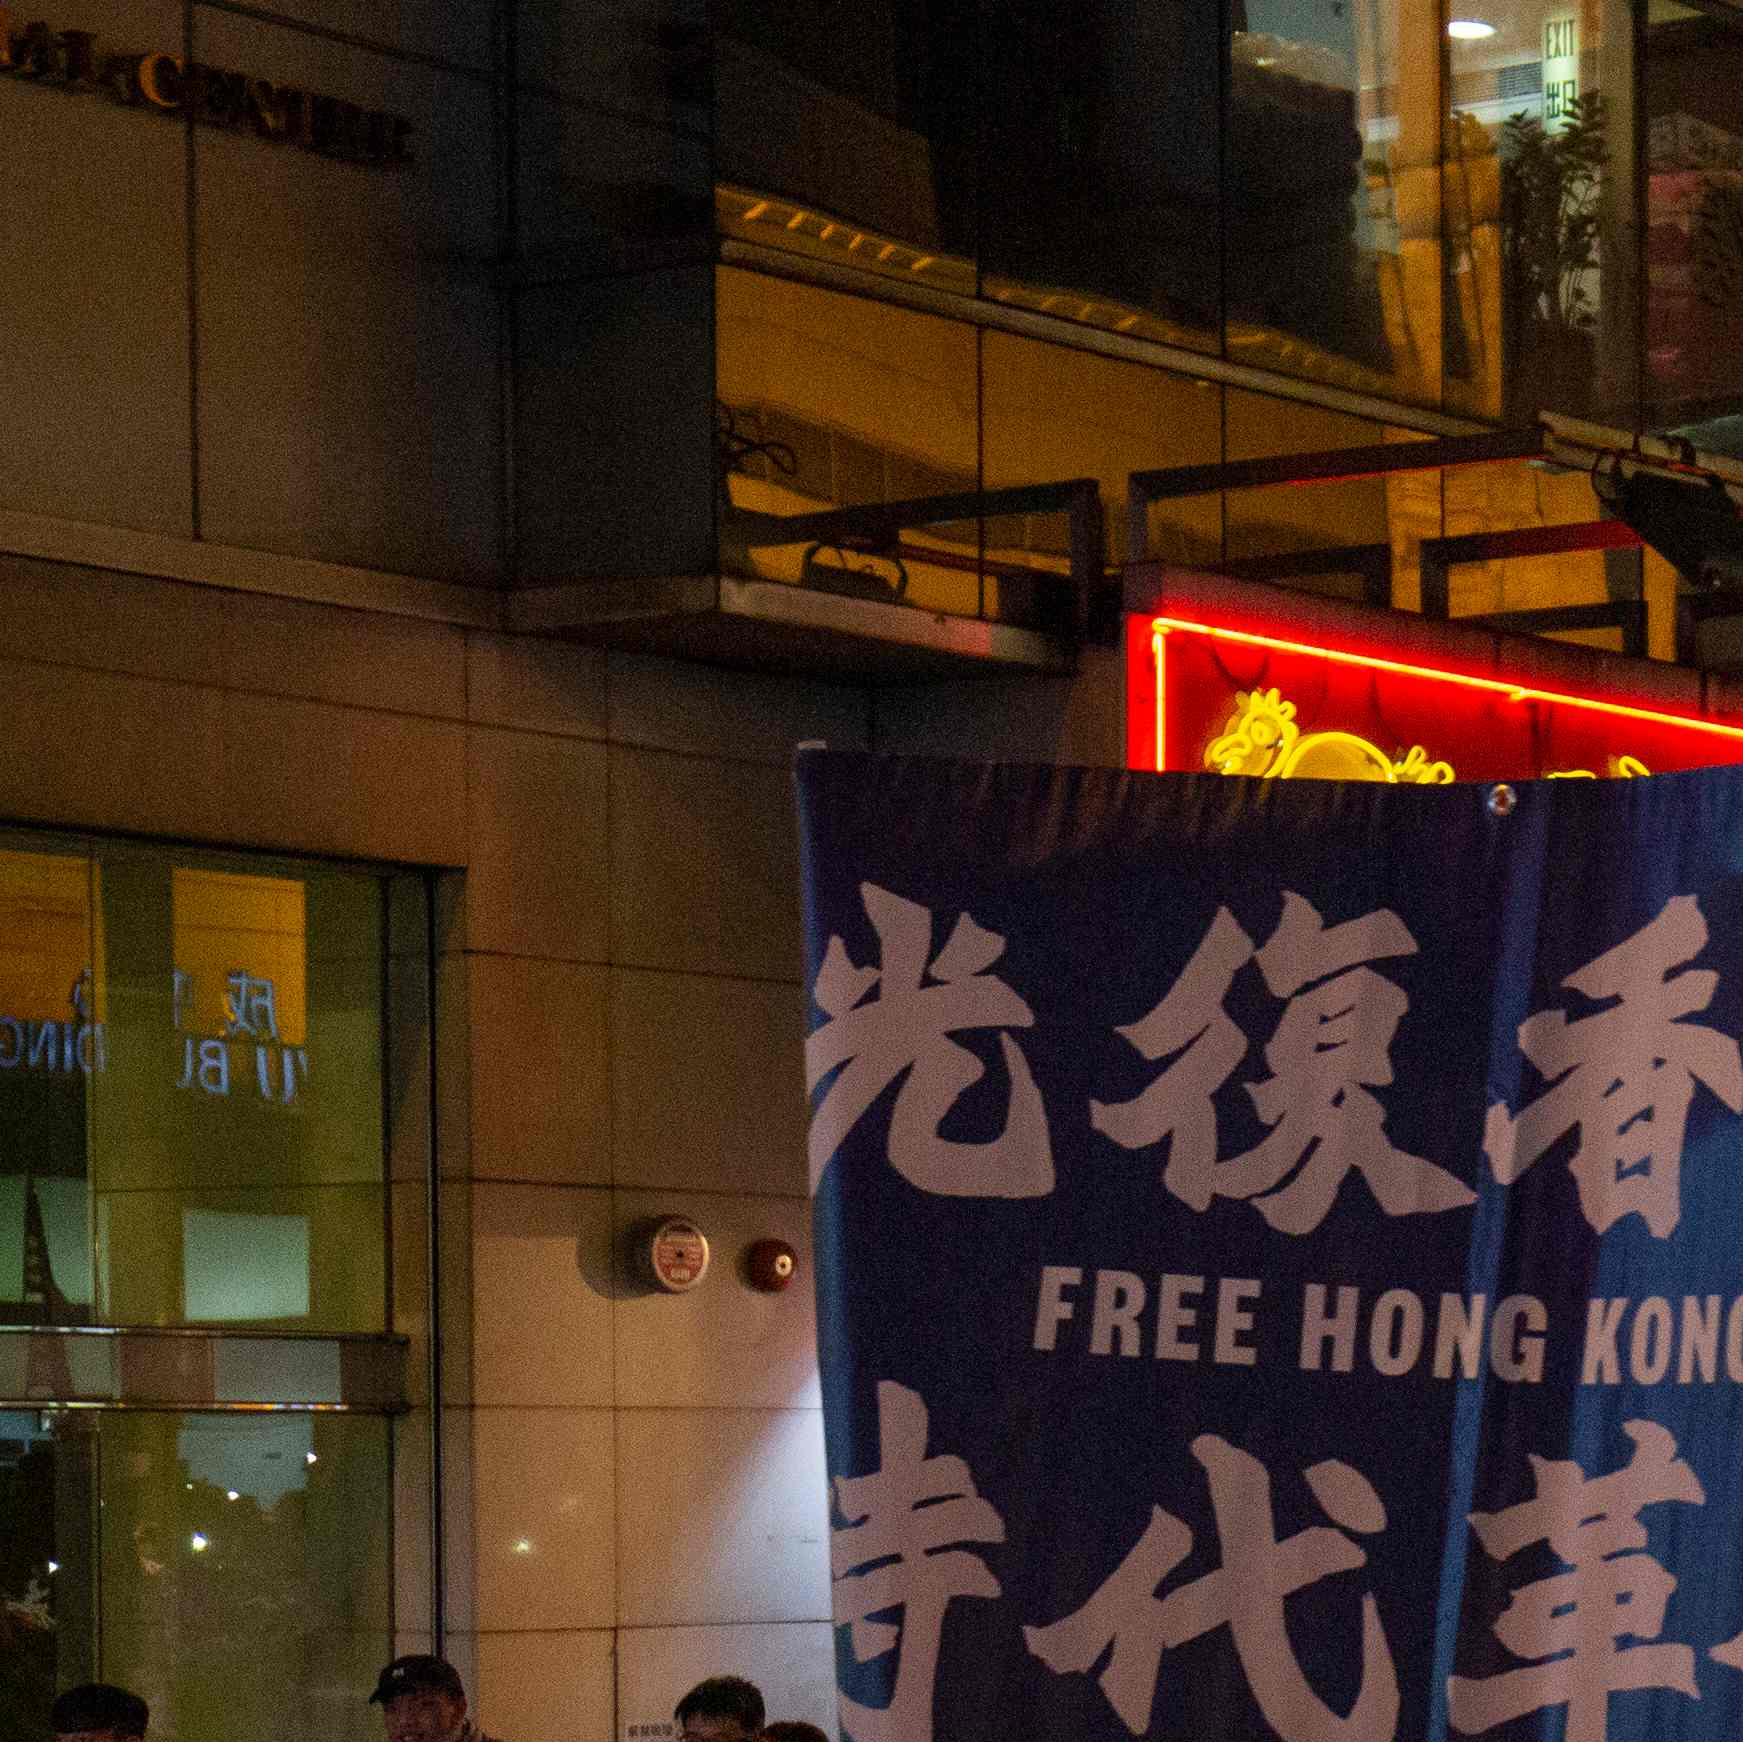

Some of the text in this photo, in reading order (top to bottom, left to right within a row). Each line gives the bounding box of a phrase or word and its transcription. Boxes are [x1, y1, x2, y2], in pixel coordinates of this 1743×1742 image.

[1546, 20, 1576, 60] EXIT
[1031, 1265, 1265, 1367] FREE
[1298, 1282, 1548, 1386] HONG
